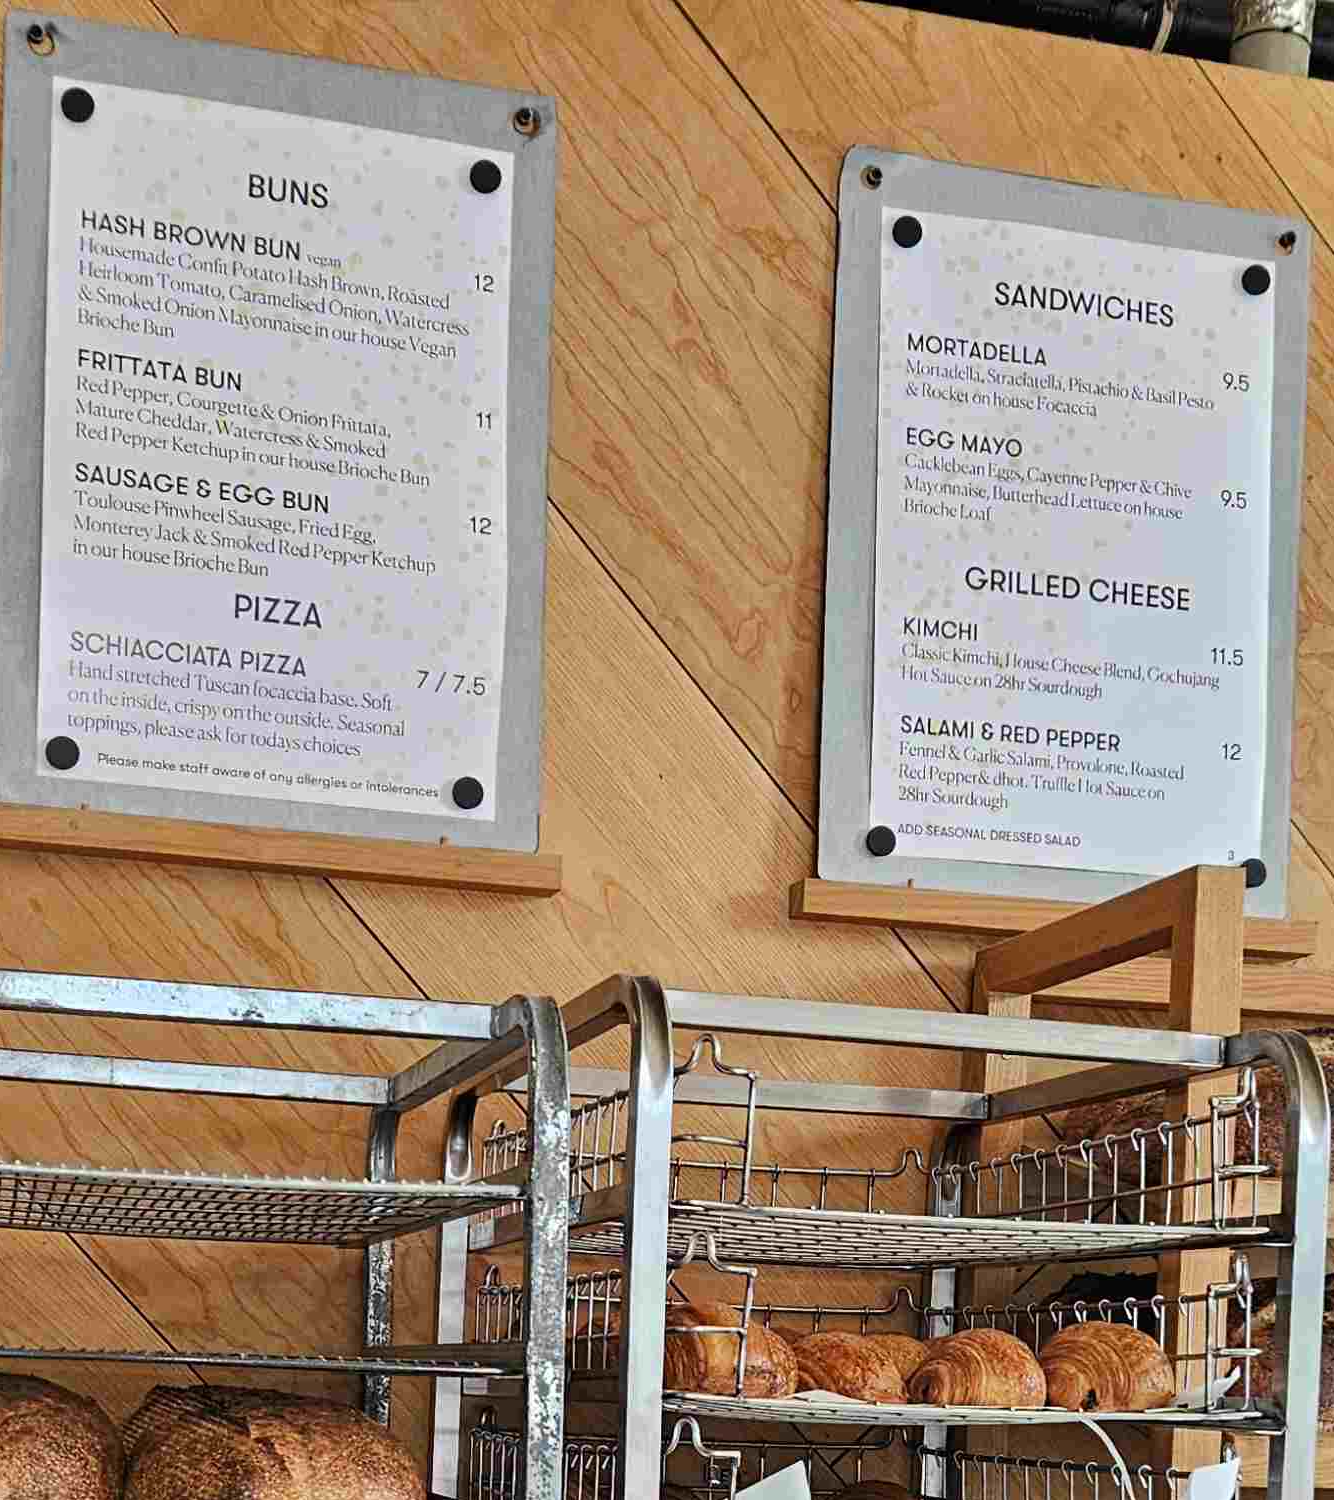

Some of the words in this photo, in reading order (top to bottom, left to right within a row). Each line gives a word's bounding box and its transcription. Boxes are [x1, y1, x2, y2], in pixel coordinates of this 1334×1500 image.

[248, 173, 329, 209] BUNS
[82, 209, 145, 239] HASH
[153, 220, 246, 254] BROWN
[254, 236, 300, 261] BUN
[306, 254, 342, 270] vegan
[79, 235, 176, 267] Housemade
[177, 252, 228, 277] Confit
[232, 260, 286, 283] Potato
[288, 267, 328, 291] Hash
[330, 274, 385, 302] Brown,
[387, 285, 450, 311] Roasted
[474, 273, 494, 294] 12
[79, 259, 154, 288] Heirloom
[156, 271, 226, 302] Tomato,
[228, 284, 326, 315] Caramelised
[328, 298, 383, 326] Onion,
[384, 306, 470, 337] Watercress
[994, 281, 1174, 328] SANDWICHES
[78, 348, 188, 384] FRITTATA
[195, 366, 242, 392] BUN
[907, 333, 1047, 366] MORTADELLA
[906, 357, 985, 385] Mortadella,
[985, 367, 1066, 393] Straciatella,
[1068, 377, 1129, 399] Pistachio
[1131, 384, 1144, 401] &
[1146, 387, 1176, 406] Basil
[1178, 391, 1214, 410] Pesto
[1222, 372, 1250, 393] 9.5
[75, 398, 135, 423] Mature
[136, 407, 212, 436] Cheddar,
[215, 418, 304, 447] Watercress
[305, 432, 321, 450] &
[322, 434, 386, 459] Smoked
[476, 411, 492, 430] 11
[906, 426, 956, 450] EGG
[961, 433, 1023, 458] MAYO
[75, 462, 189, 496] SAUSAGE
[196, 479, 212, 499] &
[219, 481, 276, 506] EGG
[282, 490, 329, 514] BUN
[904, 452, 985, 480] Cacklebean
[987, 461, 1025, 485] Eggs,
[1025, 466, 1088, 488] Cayenne
[1090, 472, 1138, 495] Pepper
[1139, 479, 1152, 497] &
[1154, 481, 1192, 499] Chive
[74, 489, 152, 515] Toulouse
[154, 499, 225, 525] Pinwheel
[227, 509, 297, 536] Sausage,
[298, 518, 340, 539] Fried
[342, 523, 376, 547] Egg,
[904, 475, 991, 502] Mayonnaise,
[992, 484, 1069, 507] Butterhead
[1070, 492, 1123, 513] Lettuce
[1123, 503, 1142, 516] on
[1143, 500, 1183, 520] house
[1220, 489, 1247, 510] 9.5
[74, 513, 154, 543] Monterey
[154, 523, 190, 544] Jack
[192, 528, 209, 546] &
[210, 530, 276, 554] Smoked
[278, 538, 310, 559] Red
[312, 543, 372, 567] Pepper
[370, 549, 436, 577] Ketchup
[469, 516, 492, 536] 12
[965, 566, 1081, 600] GRILLED
[1089, 578, 1190, 611] CHEESE
[234, 593, 322, 629] PIZZA
[903, 616, 978, 641] KIMCHI
[70, 630, 232, 669] SCHIACCIATA
[240, 650, 307, 678] PIZZA
[1211, 647, 1244, 667] 11.5
[417, 669, 430, 689] 7
[434, 671, 447, 693] /
[453, 674, 486, 696] 7.5
[900, 714, 974, 740] SALAMI
[981, 722, 995, 742] &
[1000, 724, 1040, 745] RED
[1046, 728, 1121, 753] PEPPER
[1222, 743, 1242, 761] 12
[97, 751, 139, 769] Please
[142, 759, 177, 772] make
[179, 762, 209, 775] staff
[211, 767, 251, 779] aware
[252, 768, 266, 780] of
[268, 773, 293, 786] any
[296, 773, 348, 790] allergies
[349, 781, 363, 790] or
[365, 779, 439, 798] intolerances
[898, 823, 924, 836] ADD
[924, 824, 987, 841] SEASONAL
[989, 828, 1043, 844] DRESSED
[1044, 833, 1081, 848] SALAD
